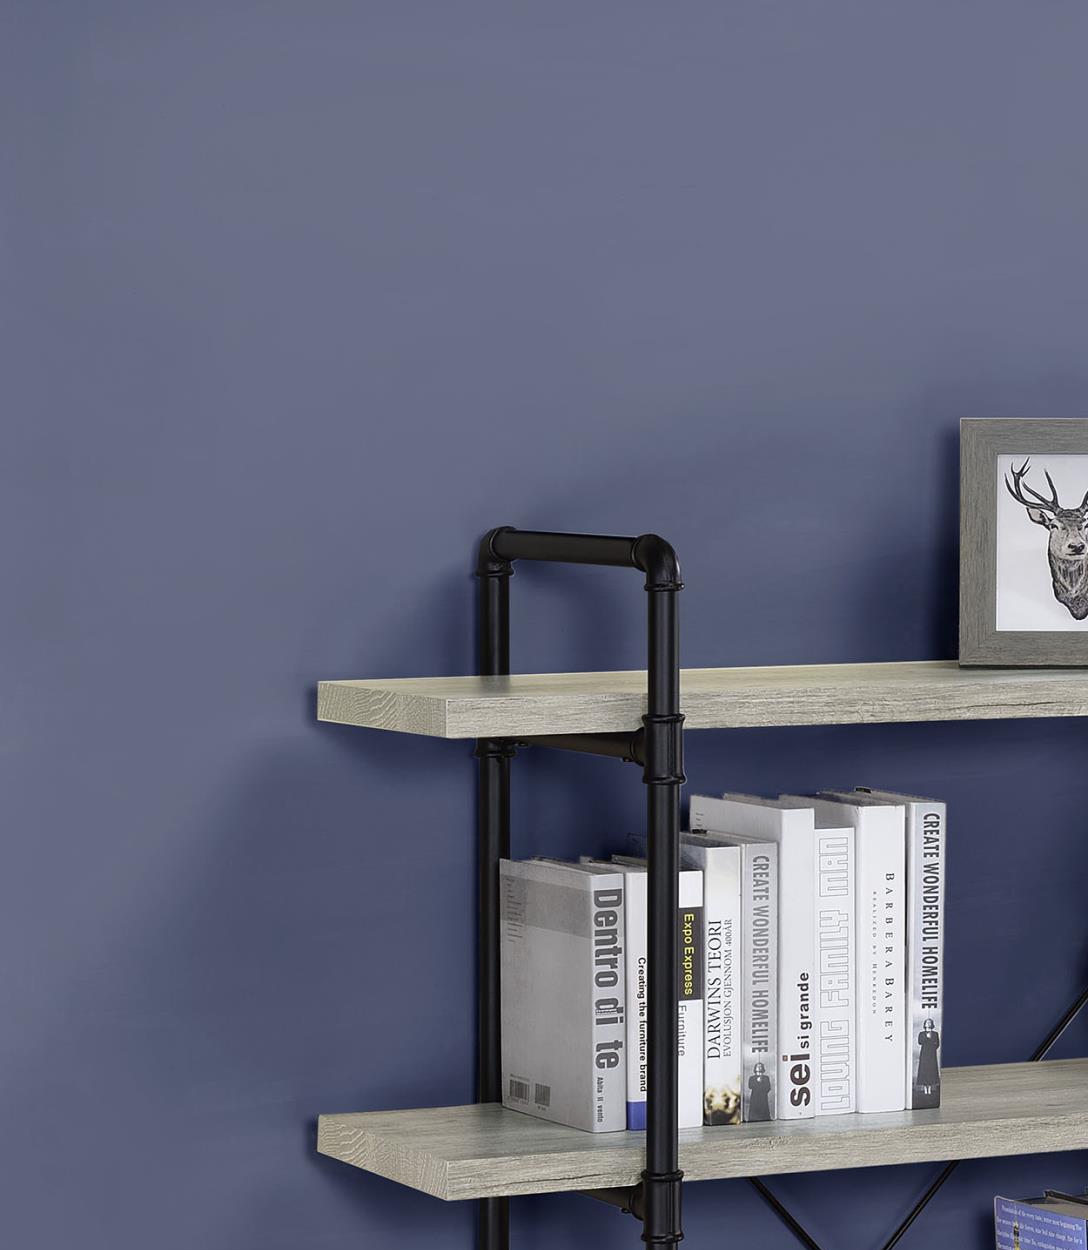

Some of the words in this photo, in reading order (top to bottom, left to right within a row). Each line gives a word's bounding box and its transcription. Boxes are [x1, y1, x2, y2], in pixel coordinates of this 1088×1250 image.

[922, 813, 940, 859] CREATE
[752, 855, 770, 902] CREATE
[819, 836, 849, 898] MAN
[682, 913, 695, 944] Expo
[885, 873, 895, 968] BARBERA
[922, 862, 940, 942] WONDERFUL
[593, 888, 623, 988] Dentro
[707, 920, 722, 974] TEORI
[752, 905, 770, 986] WONDERFUL
[819, 909, 849, 1009] FAMILY
[637, 957, 647, 999] Creating
[682, 946, 695, 995] Express
[723, 949, 734, 998] GJENNOM
[921, 946, 939, 1009] HOMELIFE
[595, 997, 623, 1026] di
[638, 1001, 647, 1018] the
[707, 977, 721, 1059] DARWINS
[751, 990, 769, 1053] HOMELIFE
[797, 971, 813, 1030] grande
[885, 978, 894, 1042] BAREY
[595, 1039, 623, 1070] te
[639, 1020, 647, 1061] furniture
[678, 1005, 687, 1057] Furniture
[723, 1000, 734, 1057] EVOLUSJON
[797, 1035, 810, 1049] si
[639, 1064, 647, 1092] brand
[782, 1053, 811, 1107] sei
